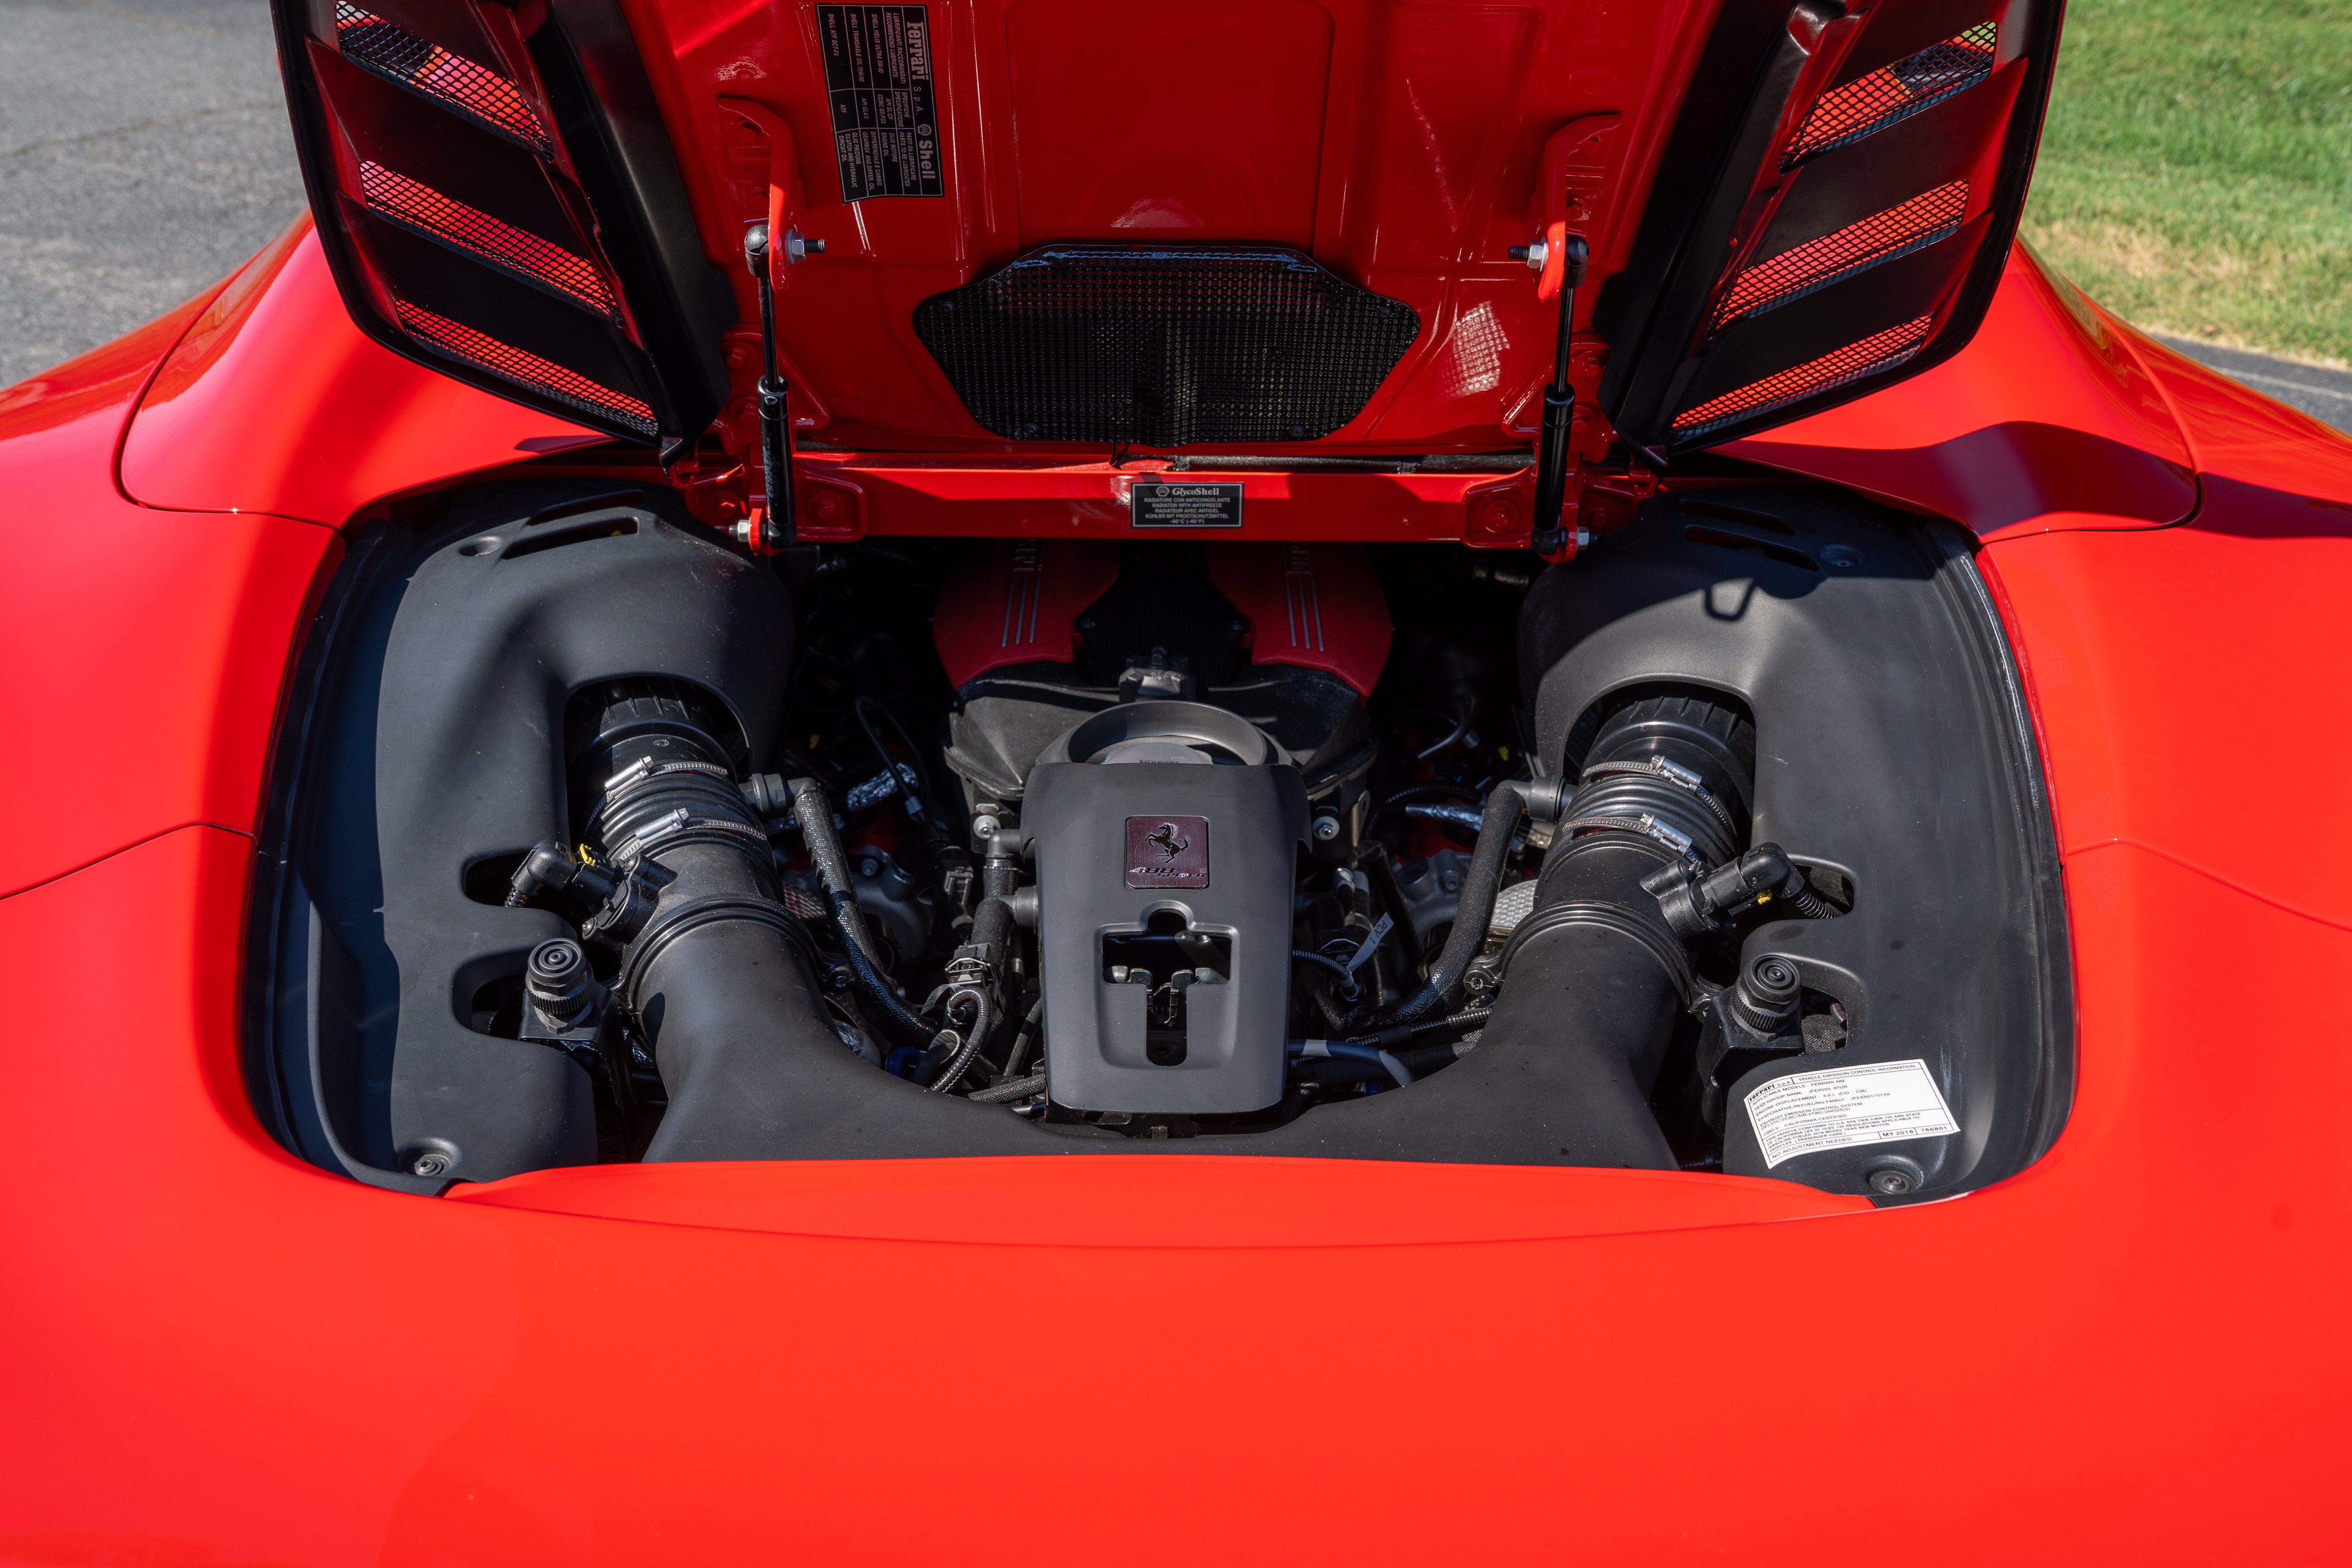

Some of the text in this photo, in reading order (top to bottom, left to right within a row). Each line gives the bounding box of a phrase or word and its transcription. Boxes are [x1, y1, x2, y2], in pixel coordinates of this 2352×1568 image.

[886, 12, 895, 48] RECOMMENDED
[853, 30, 861, 56] TRANSAXLE
[893, 13, 906, 84] LUBRIFICANTI RACCOMANDATI
[907, 22, 929, 115] Ferrari S.p.A.
[895, 91, 904, 127] SPECIFICATIONS
[871, 131, 880, 164] DIFFERENZIALE
[919, 140, 935, 179] Shell
[849, 163, 858, 187] HYDRAULIC
[1172, 487, 1220, 497] GlycoShell
[1374, 920, 1388, 938] PCV
[1749, 1084, 1775, 1102] Ferrari
[1753, 1089, 1781, 1106] APPLICABLE
[1755, 1102, 1765, 1111] TEST
[1756, 1105, 1774, 1116] ENGINE
[1775, 1096, 1817, 1106] DISPLACEMENT
[1760, 1115, 1783, 1127] EXHAUST
[1784, 1118, 1817, 1127] CALIFORNIA
[1775, 1131, 1803, 1142] CALIFORNIA
[1770, 1141, 1792, 1152] VEHICLES
[1782, 1141, 1823, 1154] ADJUSTMENT
